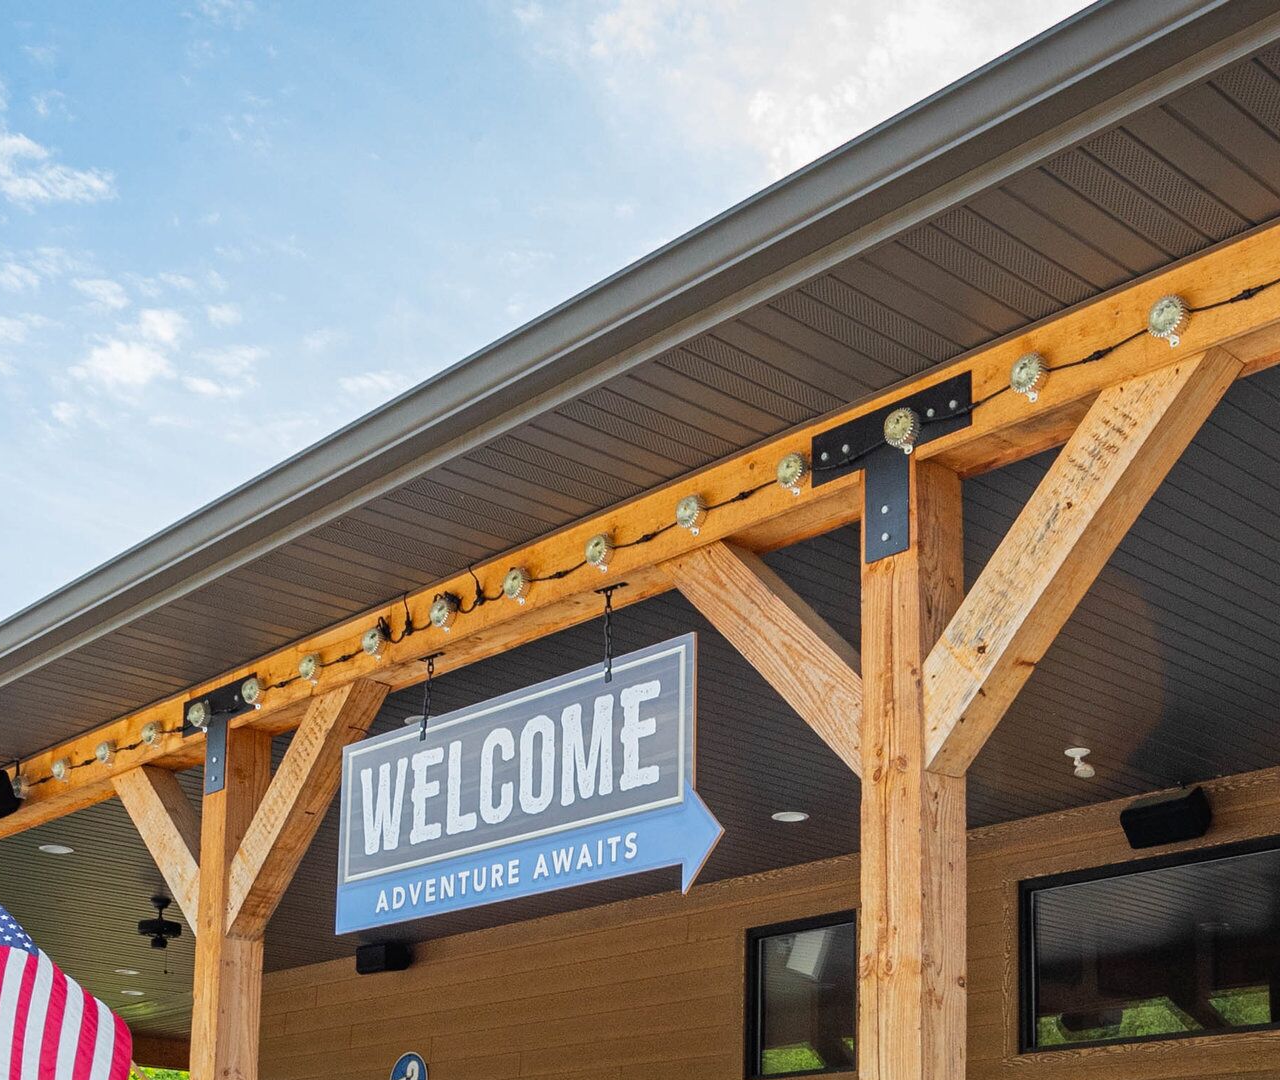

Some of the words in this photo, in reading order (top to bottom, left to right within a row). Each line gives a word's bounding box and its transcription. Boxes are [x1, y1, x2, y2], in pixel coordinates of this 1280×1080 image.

[360, 680, 661, 855] WELCOME
[375, 859, 520, 914] ADVENTURE
[533, 832, 639, 880] AWAITS
